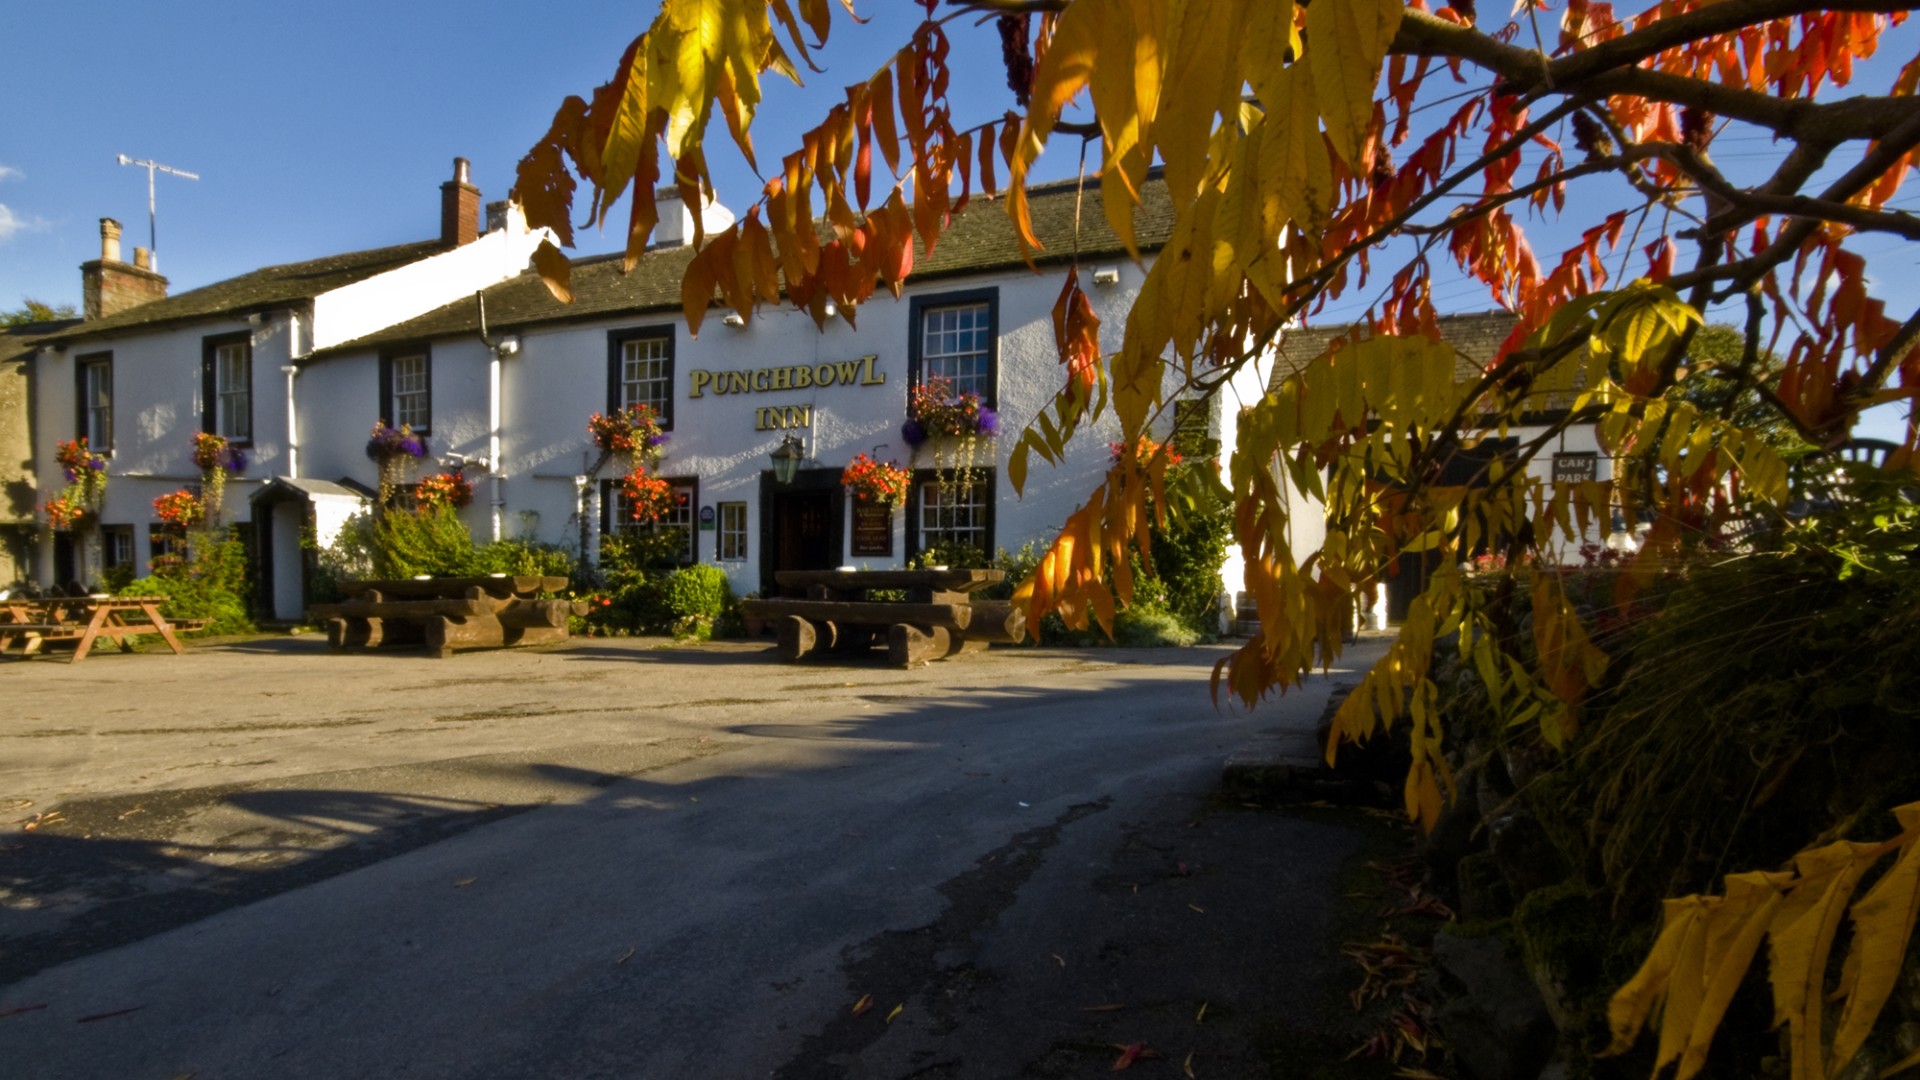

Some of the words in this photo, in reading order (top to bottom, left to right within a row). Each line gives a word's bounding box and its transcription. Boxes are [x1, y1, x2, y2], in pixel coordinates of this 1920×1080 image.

[689, 354, 886, 398] PUNCHBOWL
[755, 404, 811, 430] INN
[1558, 459, 1585, 468] CAR
[1557, 473, 1591, 484] PARK
